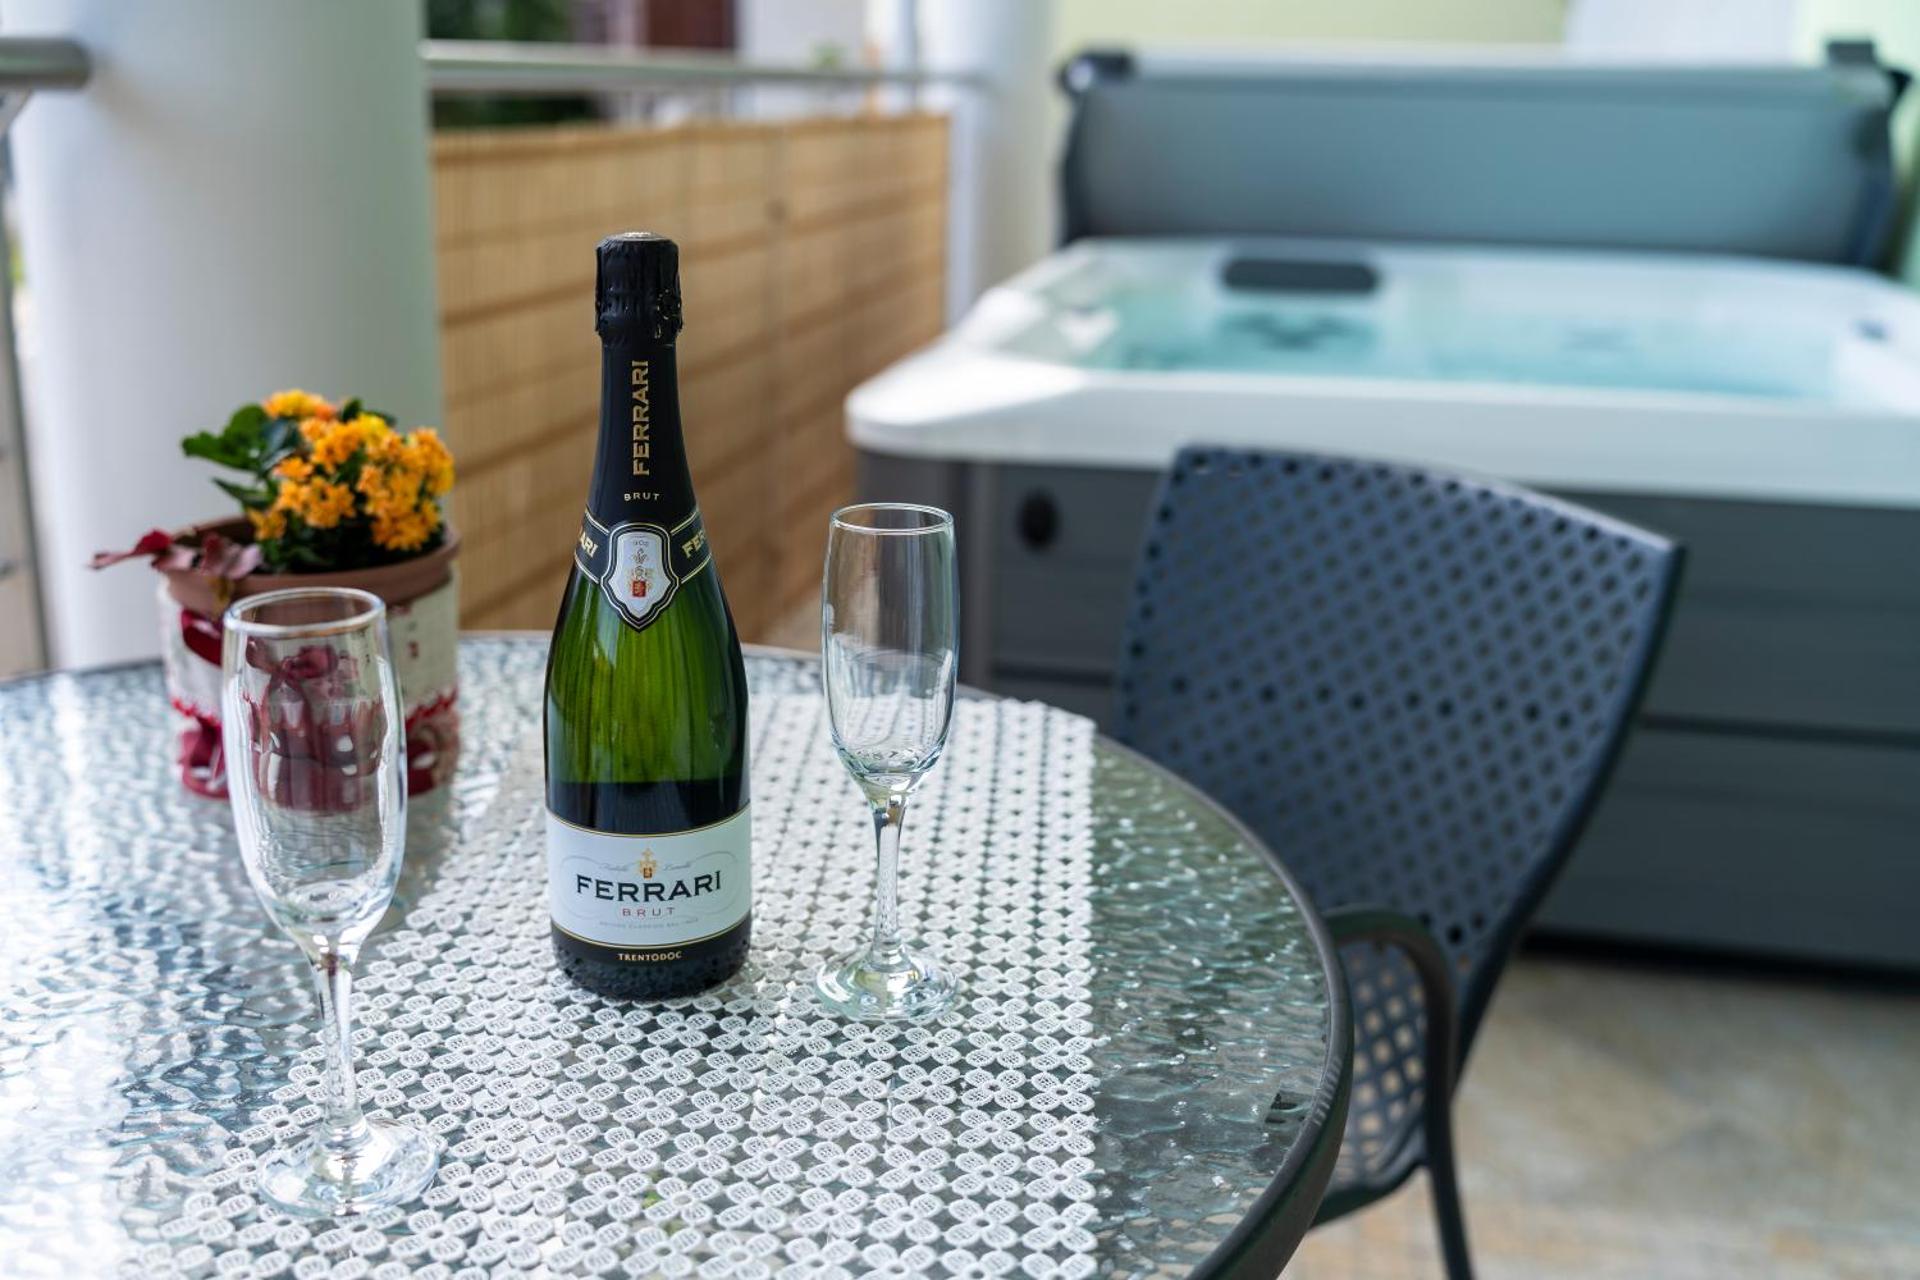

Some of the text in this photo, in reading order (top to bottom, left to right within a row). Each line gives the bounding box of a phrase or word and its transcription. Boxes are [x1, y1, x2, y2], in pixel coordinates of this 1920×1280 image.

[632, 360, 650, 476] FERRARI
[624, 492, 660, 501] BRUT
[579, 527, 599, 558] ARI
[576, 870, 721, 902] FERRARI
[622, 907, 676, 918] BRUT
[617, 951, 683, 962] TRENTODOC
